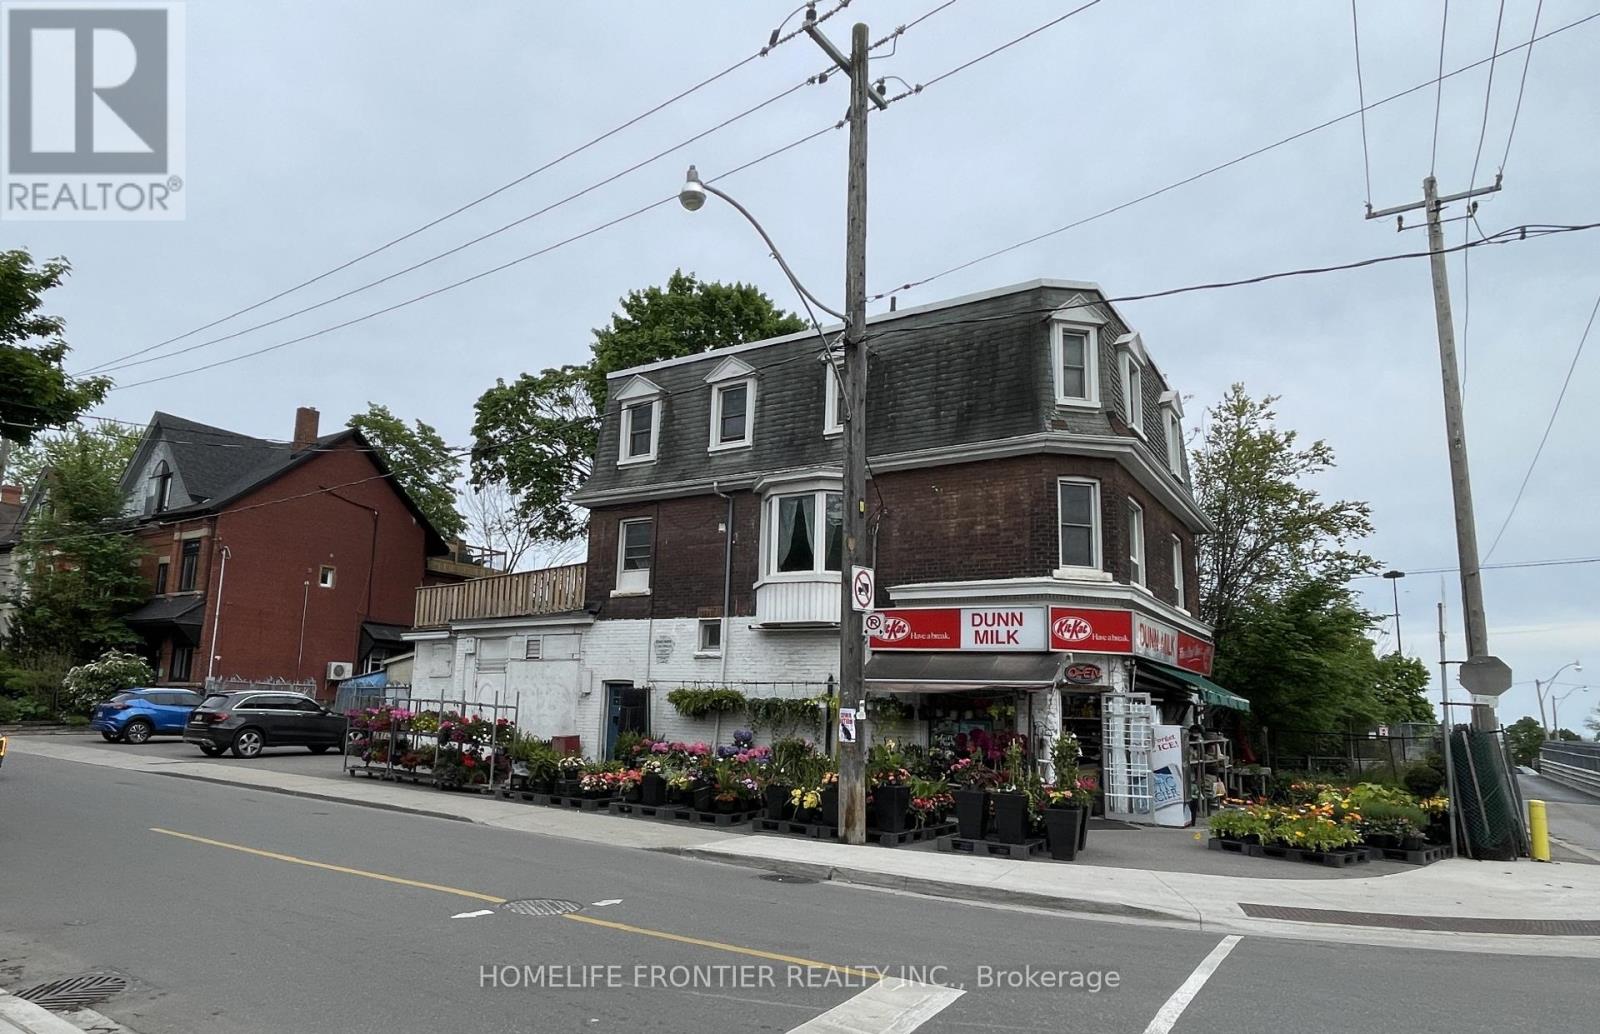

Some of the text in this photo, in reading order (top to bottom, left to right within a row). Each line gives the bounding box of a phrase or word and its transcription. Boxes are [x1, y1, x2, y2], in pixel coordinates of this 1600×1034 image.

[971, 612, 1023, 627] DUNN
[974, 629, 1019, 645] MILK
[1056, 619, 1089, 640] KitKat
[1155, 733, 1176, 744] orget
